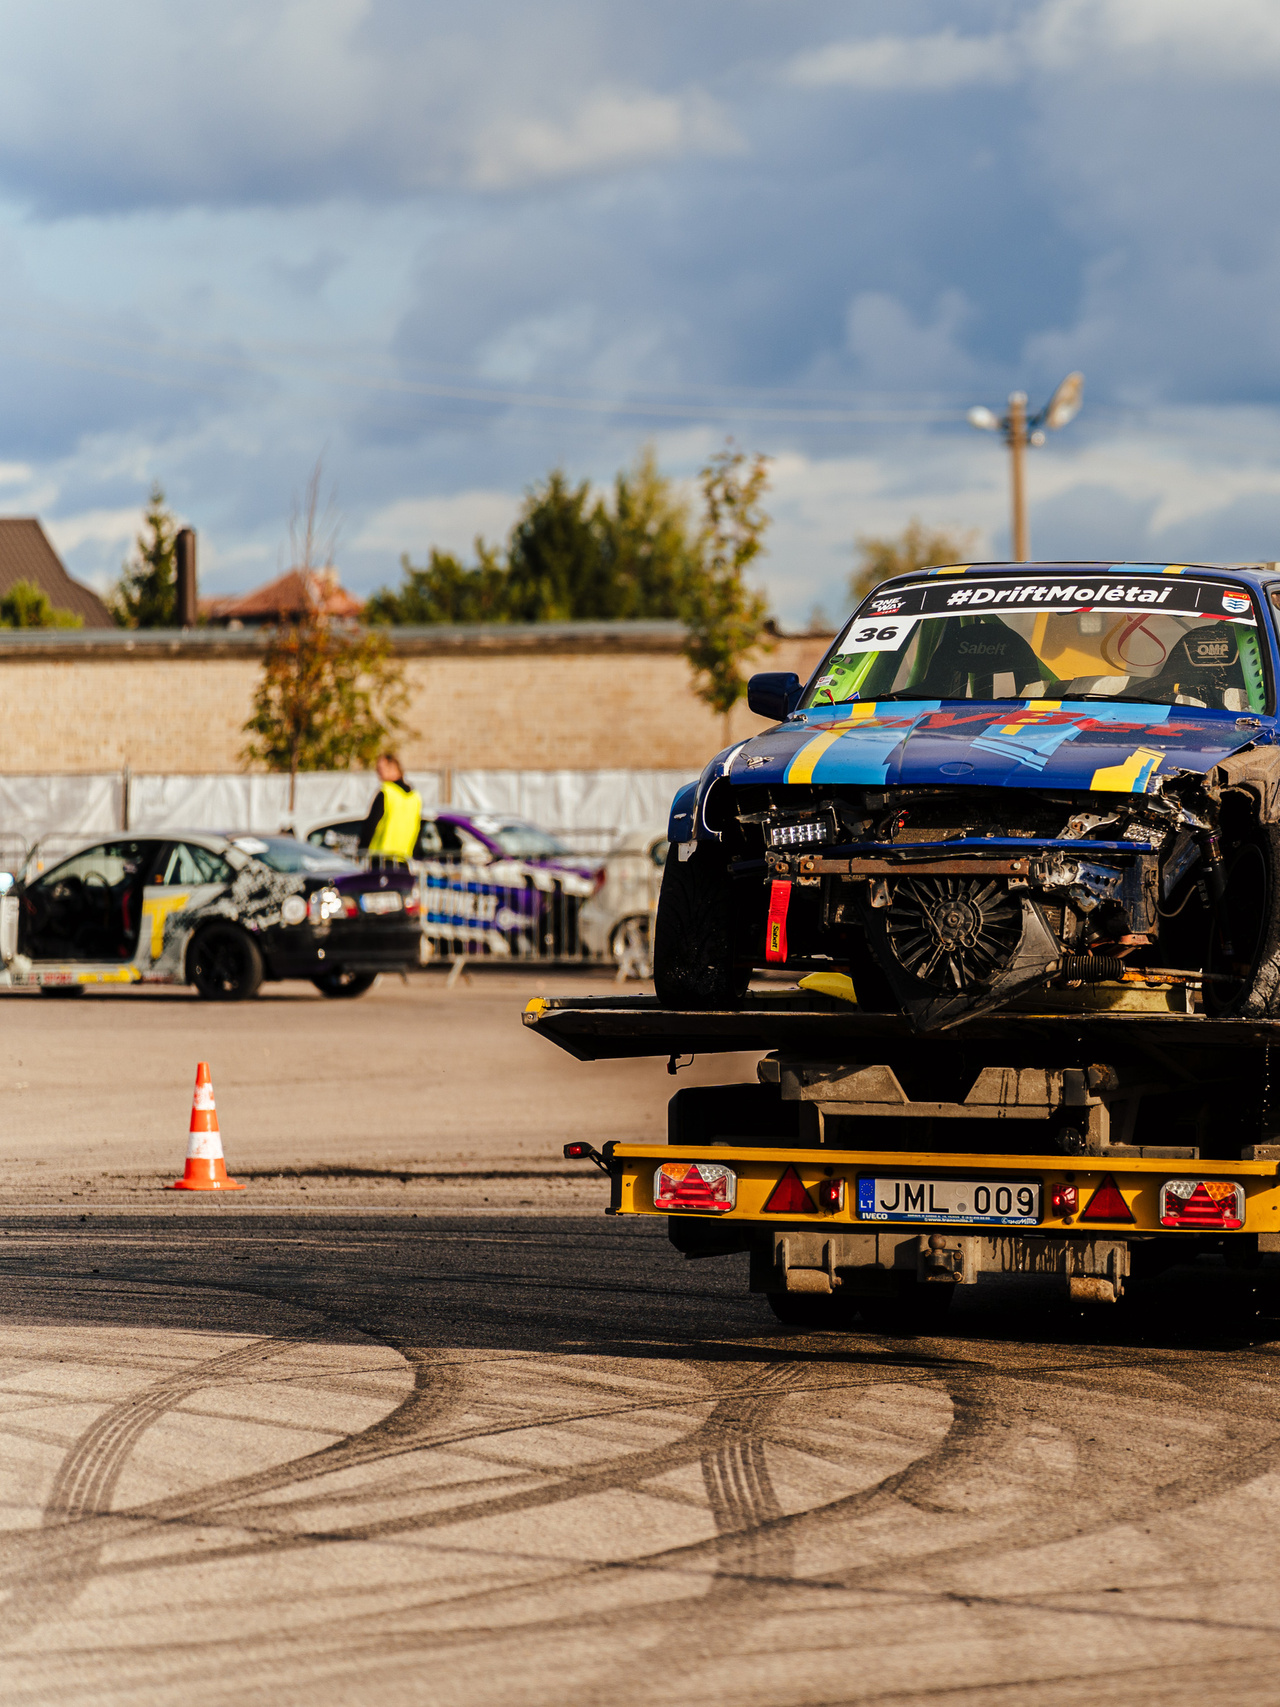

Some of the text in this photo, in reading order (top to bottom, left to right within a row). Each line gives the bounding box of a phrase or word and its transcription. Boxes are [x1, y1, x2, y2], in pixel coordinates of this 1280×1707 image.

[871, 597, 903, 609] ONE
[876, 601, 907, 613] WAY
[854, 626, 900, 643] 36
[957, 641, 1008, 656] Sabelt
[1197, 643, 1229, 657] OMP
[860, 1200, 874, 1209] LT
[879, 1182, 1035, 1216] JML 009
[862, 1212, 888, 1220] IVECO
